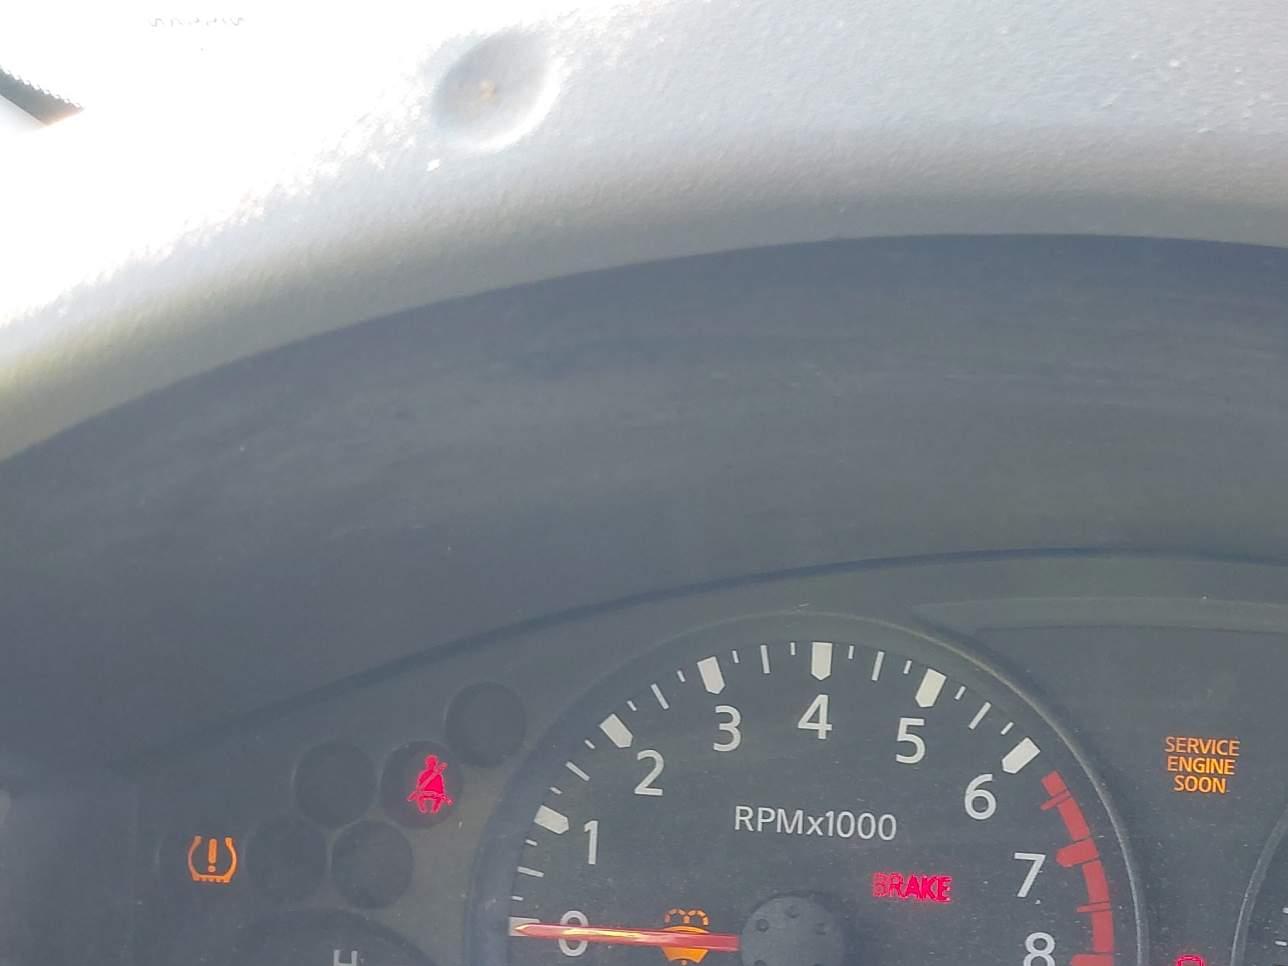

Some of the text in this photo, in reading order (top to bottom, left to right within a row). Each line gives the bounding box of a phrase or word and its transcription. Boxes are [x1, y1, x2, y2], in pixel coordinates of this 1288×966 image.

[714, 706, 740, 751] 3
[798, 695, 832, 739] 4
[896, 718, 925, 763] 5
[1164, 736, 1240, 756] SERVICE
[635, 750, 663, 795] 2
[1167, 756, 1235, 775] ENGINE
[1174, 775, 1226, 794] SOON
[965, 774, 996, 819] 6
[585, 821, 597, 864] 1
[735, 806, 896, 840] RPMx1000
[872, 872, 952, 904] BRAKE
[1015, 853, 1045, 897] 7
[557, 911, 589, 956] 0
